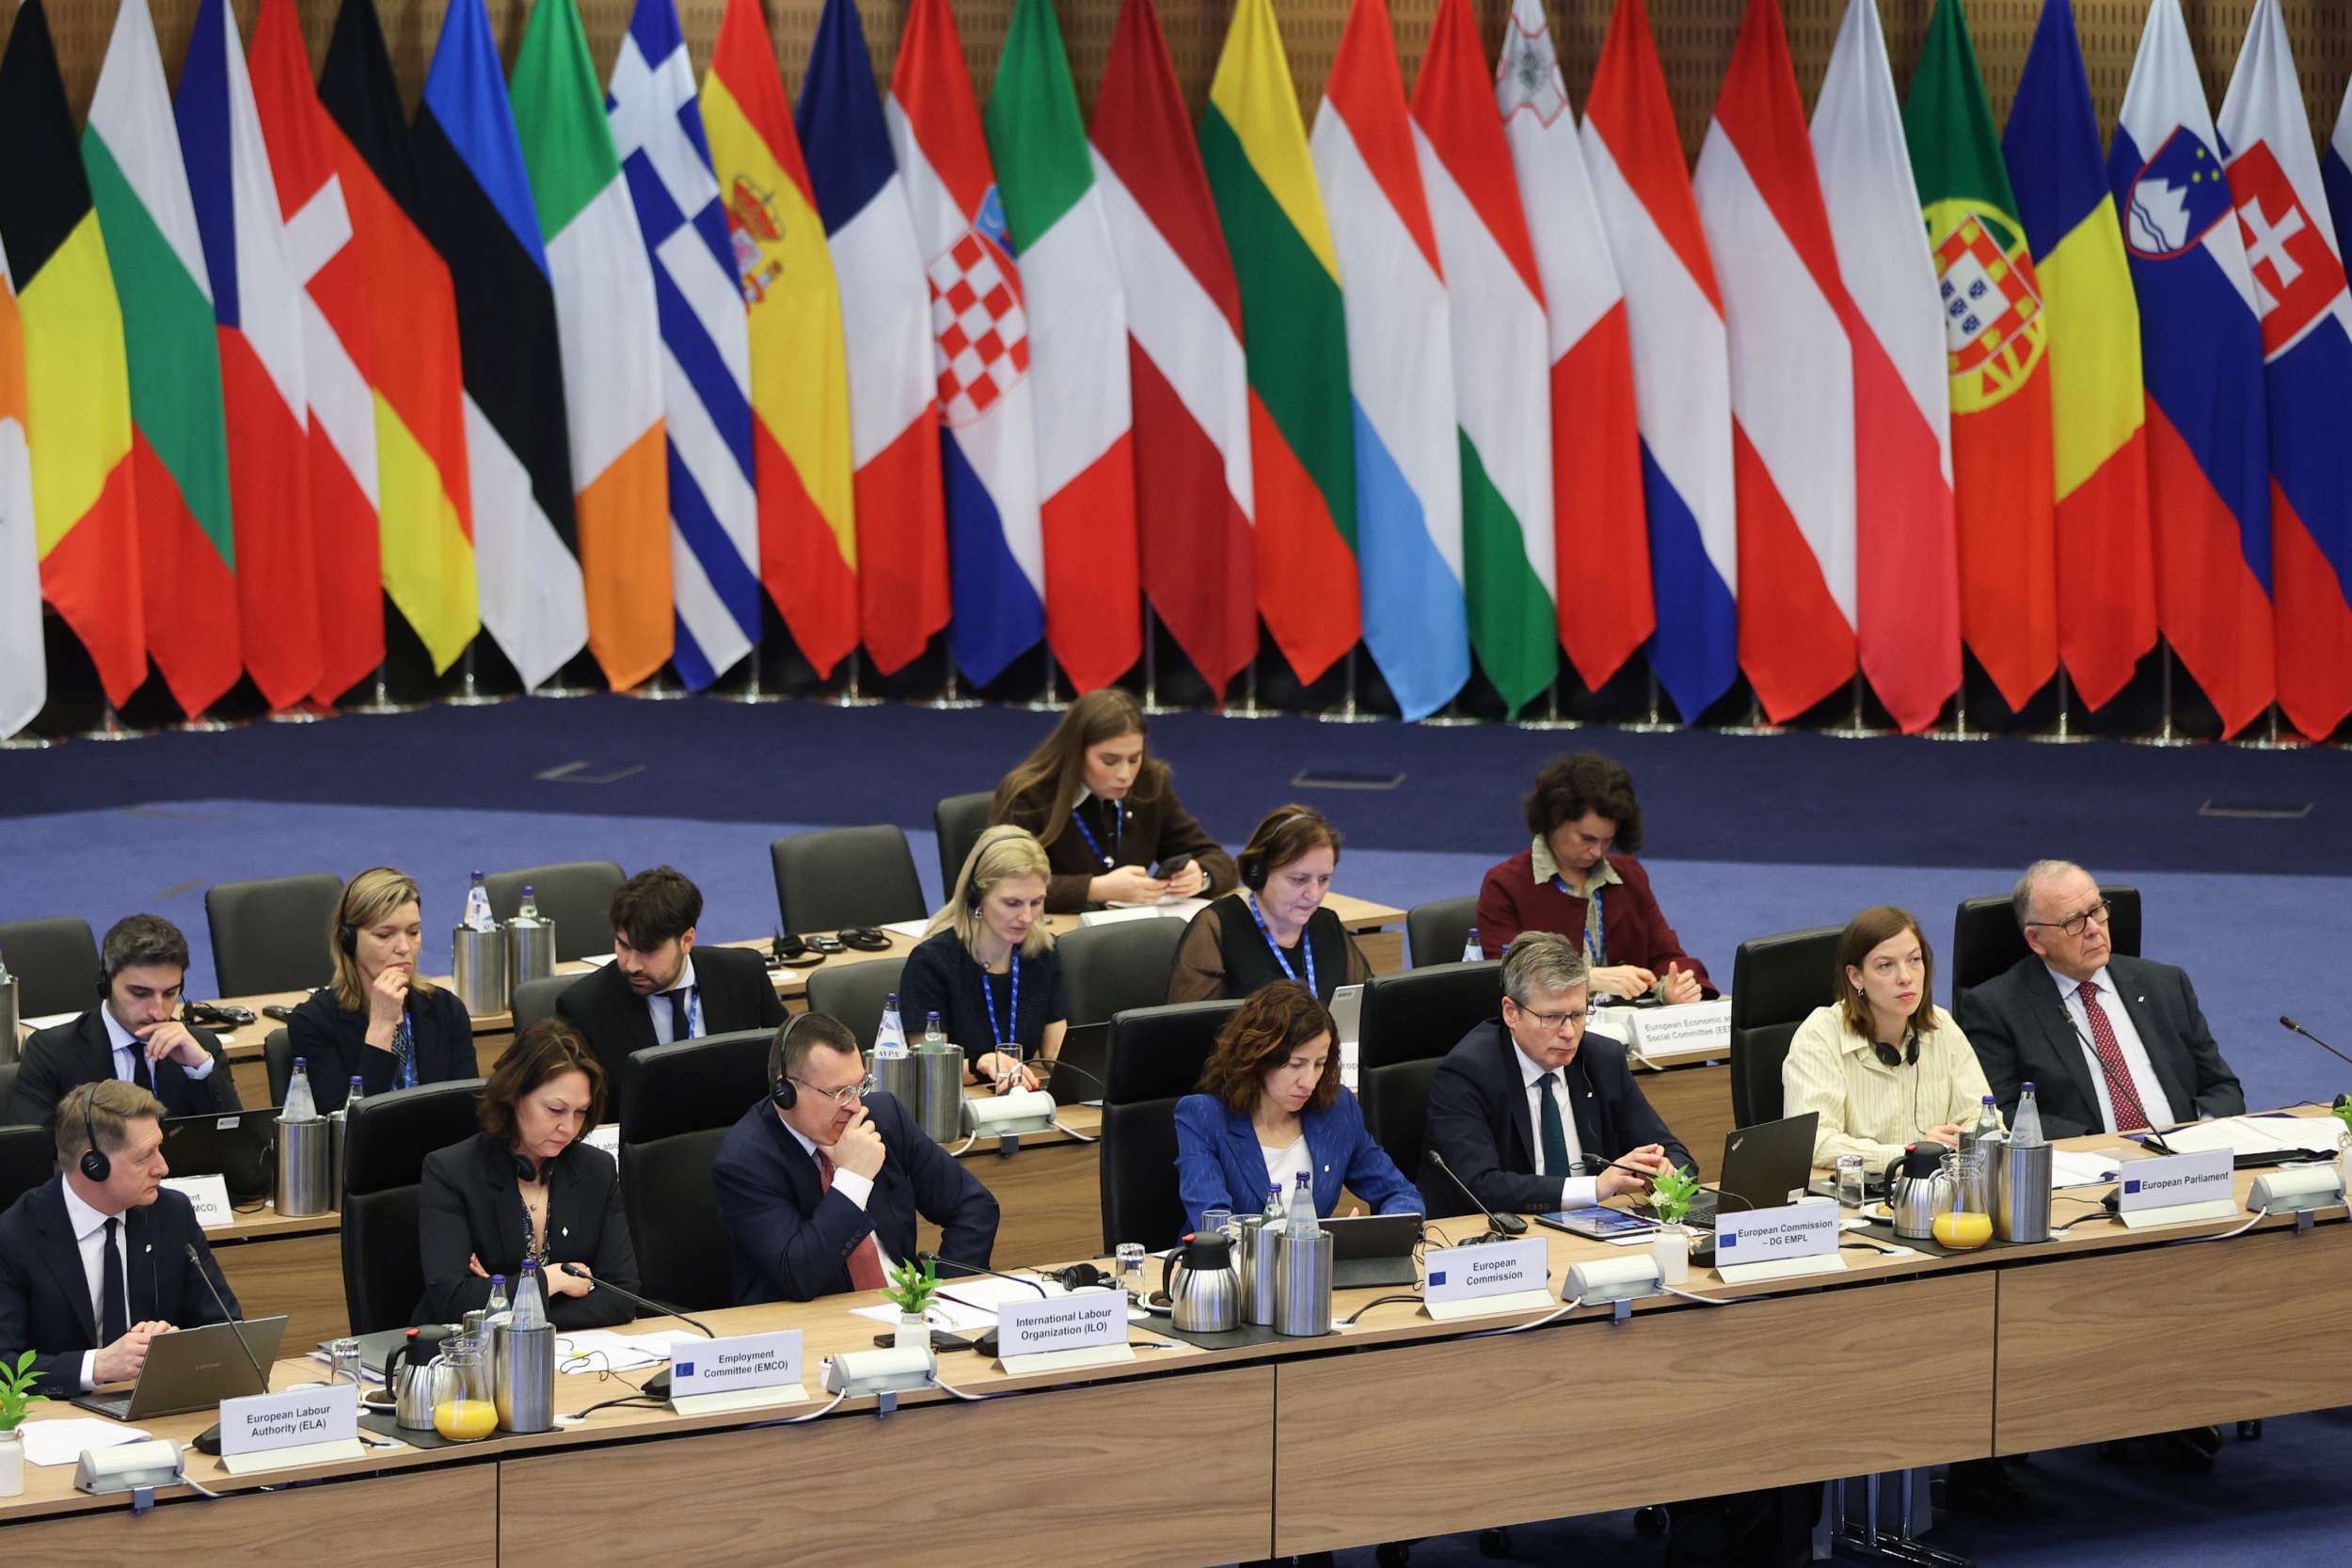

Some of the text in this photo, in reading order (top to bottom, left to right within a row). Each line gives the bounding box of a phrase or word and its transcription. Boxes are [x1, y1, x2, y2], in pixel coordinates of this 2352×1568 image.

[1645, 1022, 1683, 1033] European
[1683, 1016, 1723, 1028] Economic
[1645, 1033, 1671, 1042] Social
[1672, 1028, 1713, 1039] Committee
[2142, 1171, 2229, 1191] European Parliament
[1738, 1220, 1833, 1238] European Commission
[1770, 1237, 1783, 1246] DG
[1785, 1234, 1807, 1244] EMPL
[1473, 1259, 1517, 1272] European
[1467, 1271, 1523, 1286] Commission
[1016, 1308, 1112, 1327] International Labour
[1021, 1322, 1107, 1341] Organization (ILO)
[719, 1350, 774, 1364] Employment
[704, 1360, 788, 1378] Committee (EMCO)
[246, 1405, 331, 1424] European Labour
[251, 1418, 326, 1437] Authority (ELA)
